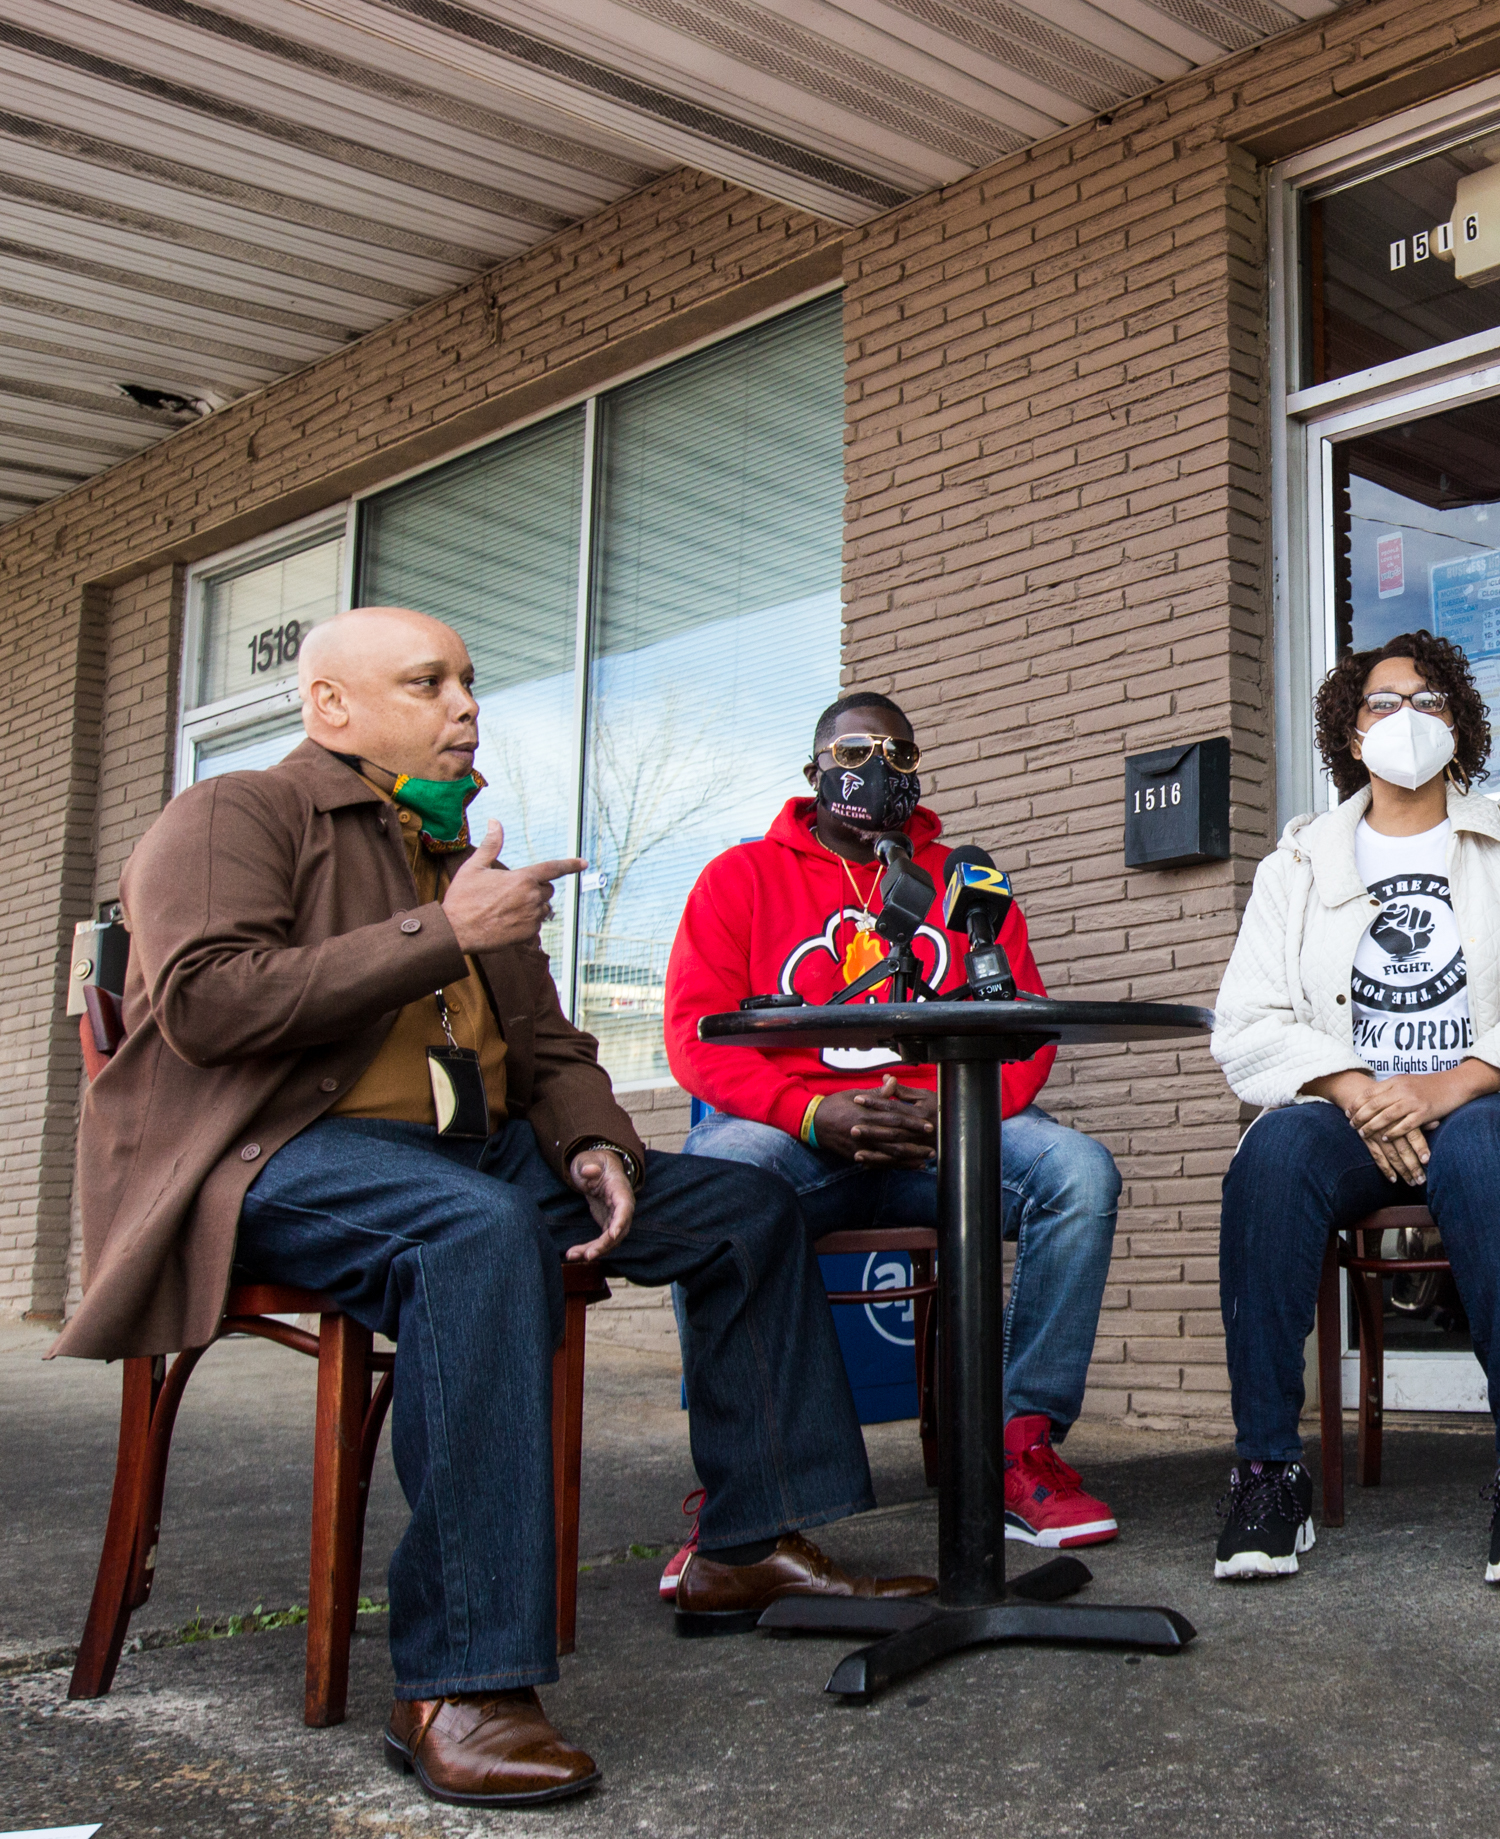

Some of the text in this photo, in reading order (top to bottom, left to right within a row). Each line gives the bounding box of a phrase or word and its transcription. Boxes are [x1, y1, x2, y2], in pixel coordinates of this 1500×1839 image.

[1394, 214, 1478, 267] 1516
[1446, 558, 1487, 579] BUSINESS
[1441, 596, 1468, 607] TUESDAY
[1441, 616, 1474, 627] THURSDAY
[248, 619, 301, 675] 1518
[831, 802, 867, 813] ATLANTA
[1134, 782, 1181, 814] 1516
[830, 807, 872, 821] FALCONS
[968, 865, 1009, 896] 2
[1382, 880, 1422, 896] THE
[1426, 881, 1451, 896] PO
[1383, 962, 1434, 976] FIGHT.
[1434, 957, 1467, 995] GHT
[986, 983, 1003, 994] MIC
[1351, 977, 1386, 1002] POW
[1391, 988, 1431, 1005] THE
[1353, 1017, 1474, 1051] EW ORDE
[1393, 1055, 1427, 1074] Rights
[1432, 1055, 1458, 1072] Orga
